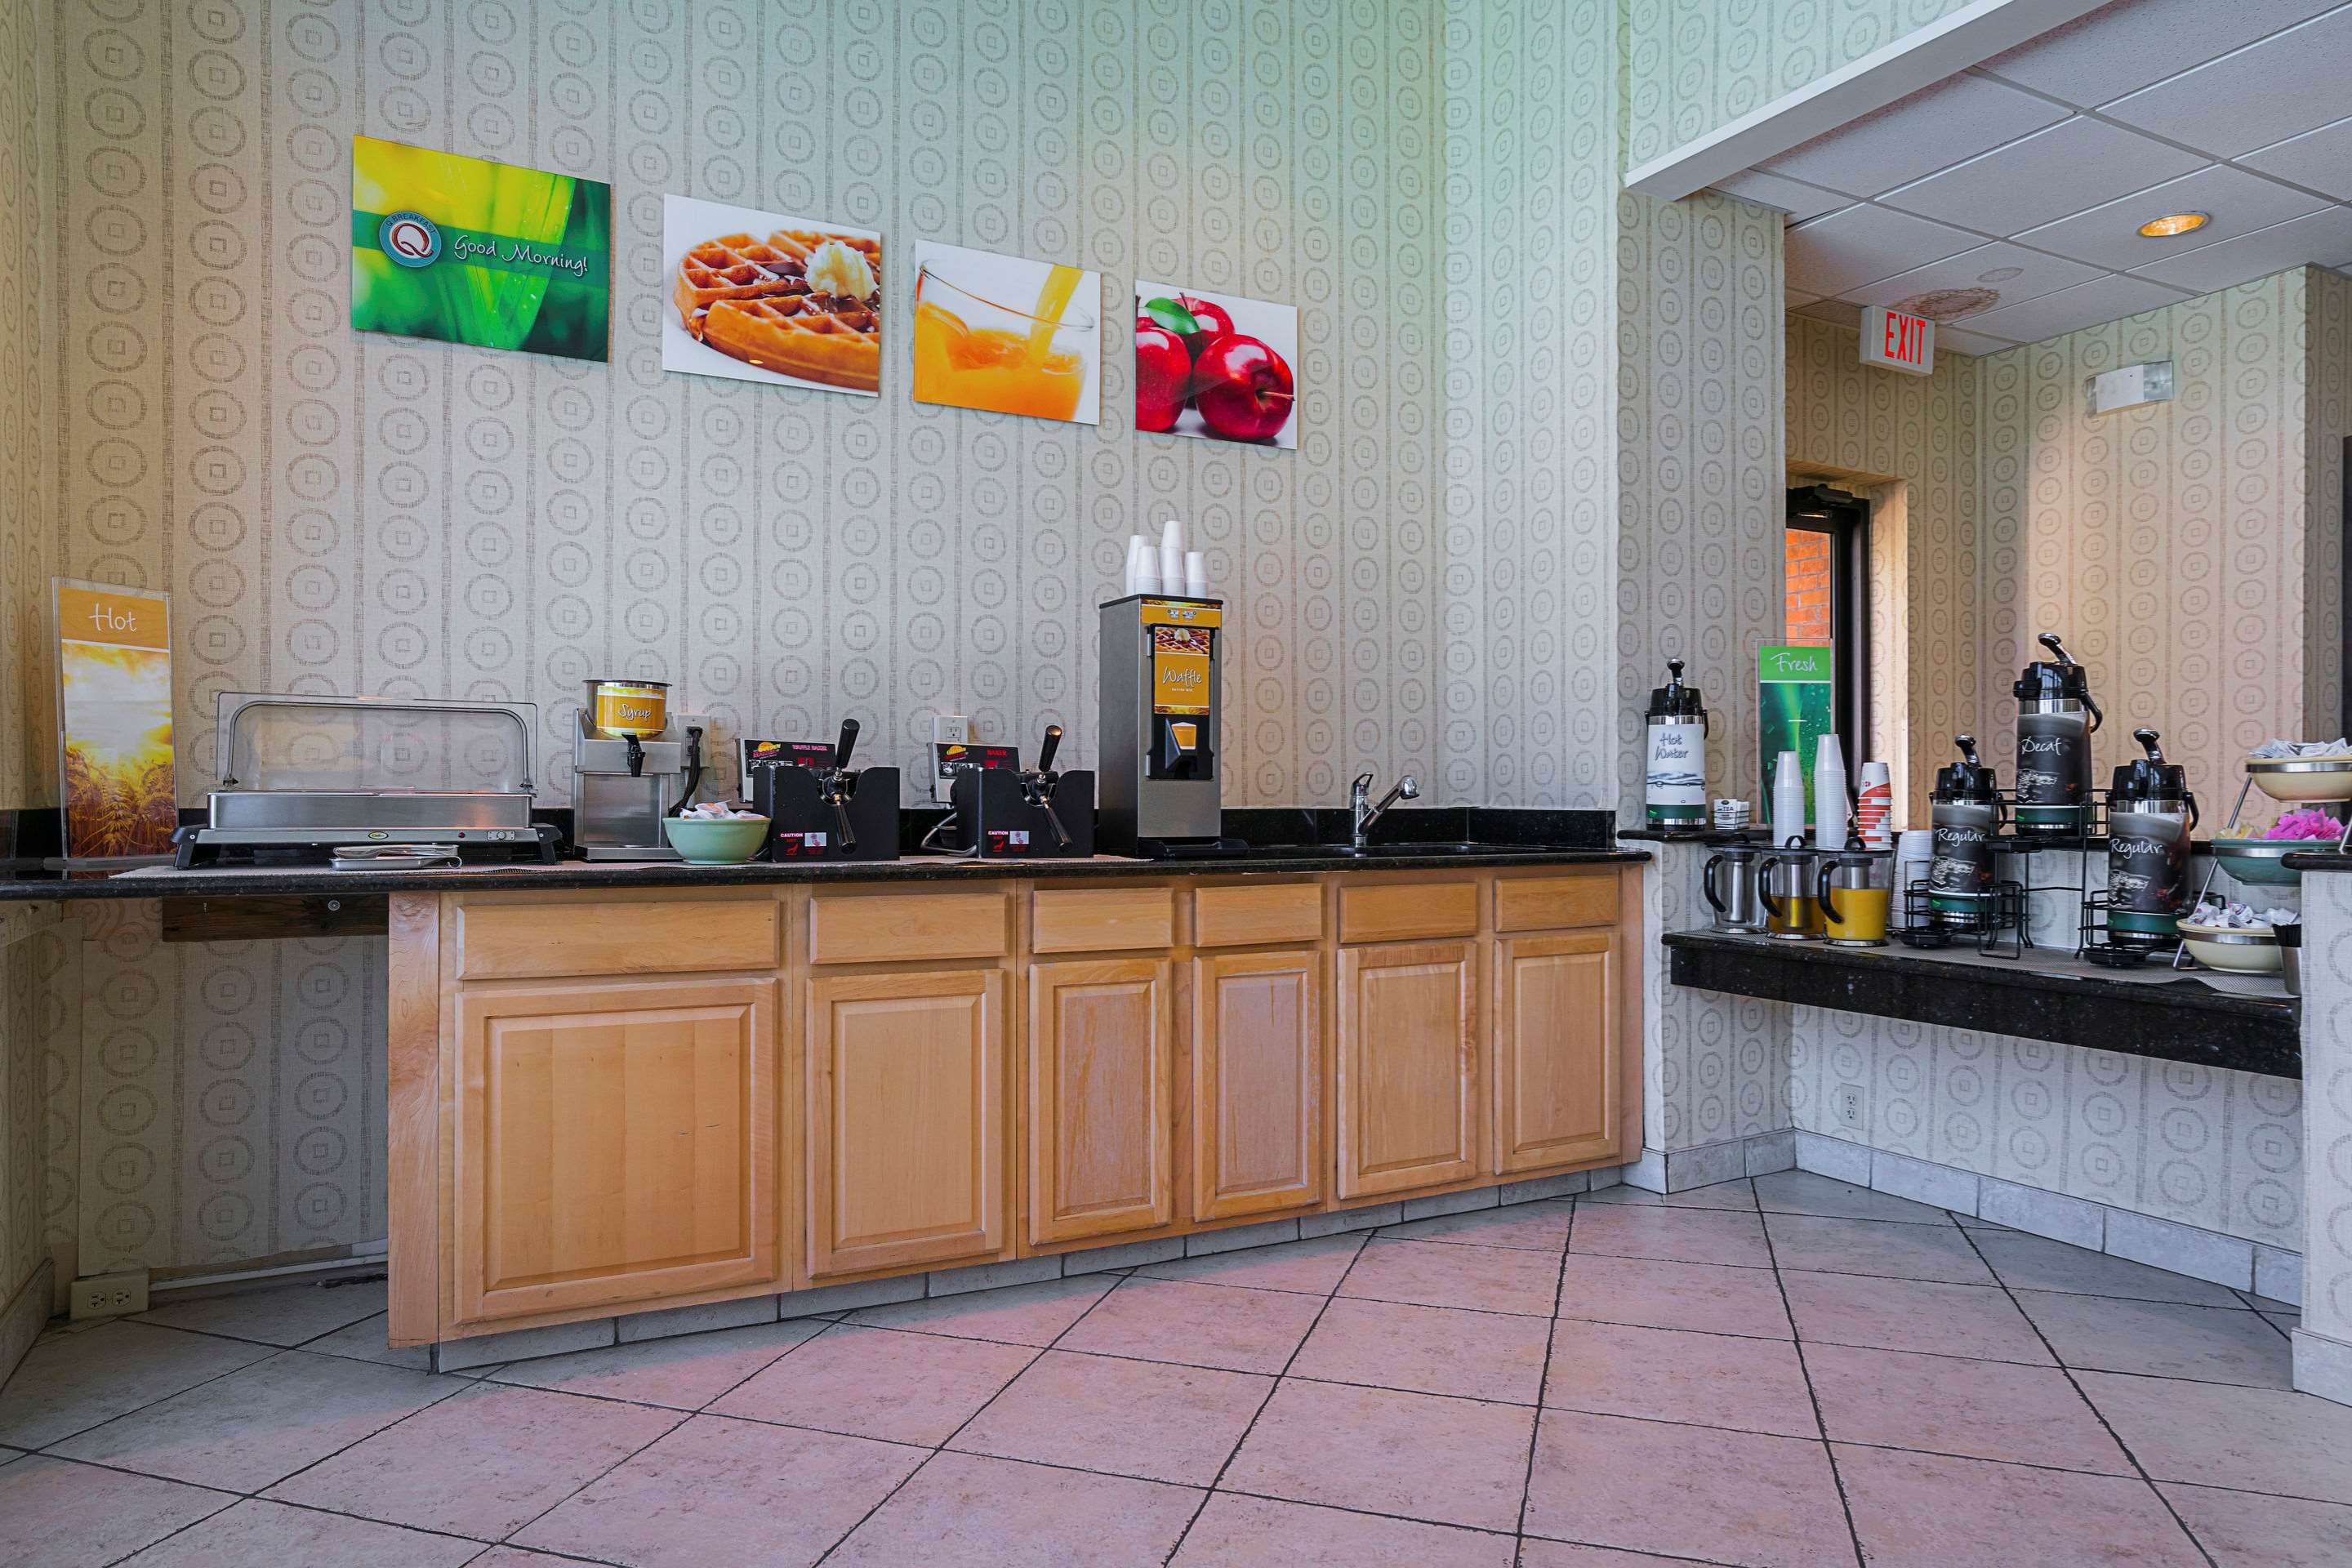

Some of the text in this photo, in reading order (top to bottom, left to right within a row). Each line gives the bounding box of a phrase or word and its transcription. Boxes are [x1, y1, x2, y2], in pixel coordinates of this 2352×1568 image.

[392, 212, 437, 234] BREAKFAST
[454, 234, 588, 277] Good Morning!
[1884, 311, 1927, 365] EXIT
[87, 603, 137, 632] Hot
[1770, 652, 1818, 673] Fresh
[1162, 666, 1203, 688] Waffle
[617, 703, 652, 721] Syrup
[1659, 732, 1683, 746] Hot
[2020, 736, 2062, 755] Decaf
[1655, 745, 1689, 760] Water
[1935, 828, 1986, 847] Regular
[2109, 838, 2163, 859] Regular
